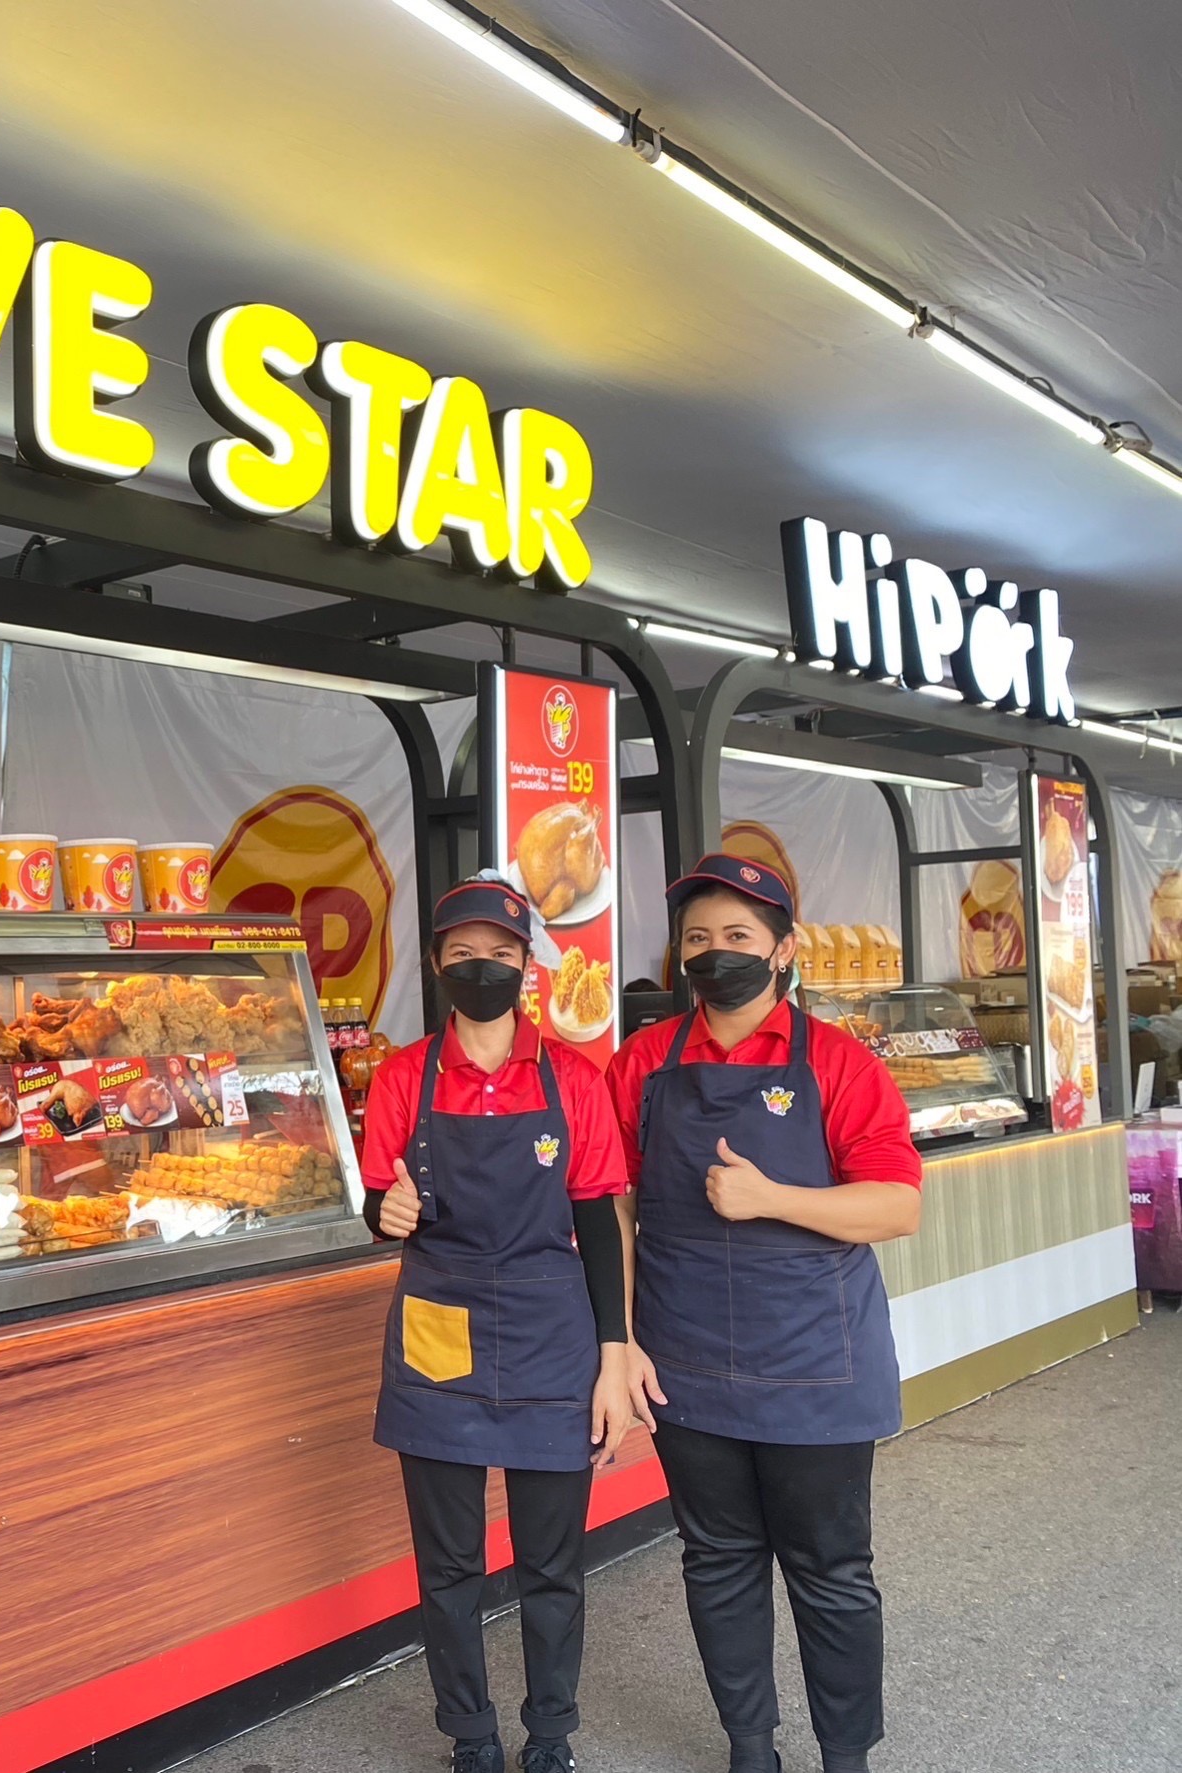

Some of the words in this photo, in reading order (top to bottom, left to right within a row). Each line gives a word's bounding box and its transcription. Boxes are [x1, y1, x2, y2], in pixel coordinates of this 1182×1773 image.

[189, 302, 593, 590] STAR
[567, 761, 594, 794] 139
[227, 1100, 244, 1117] 25
[37, 1122, 54, 1139] 39
